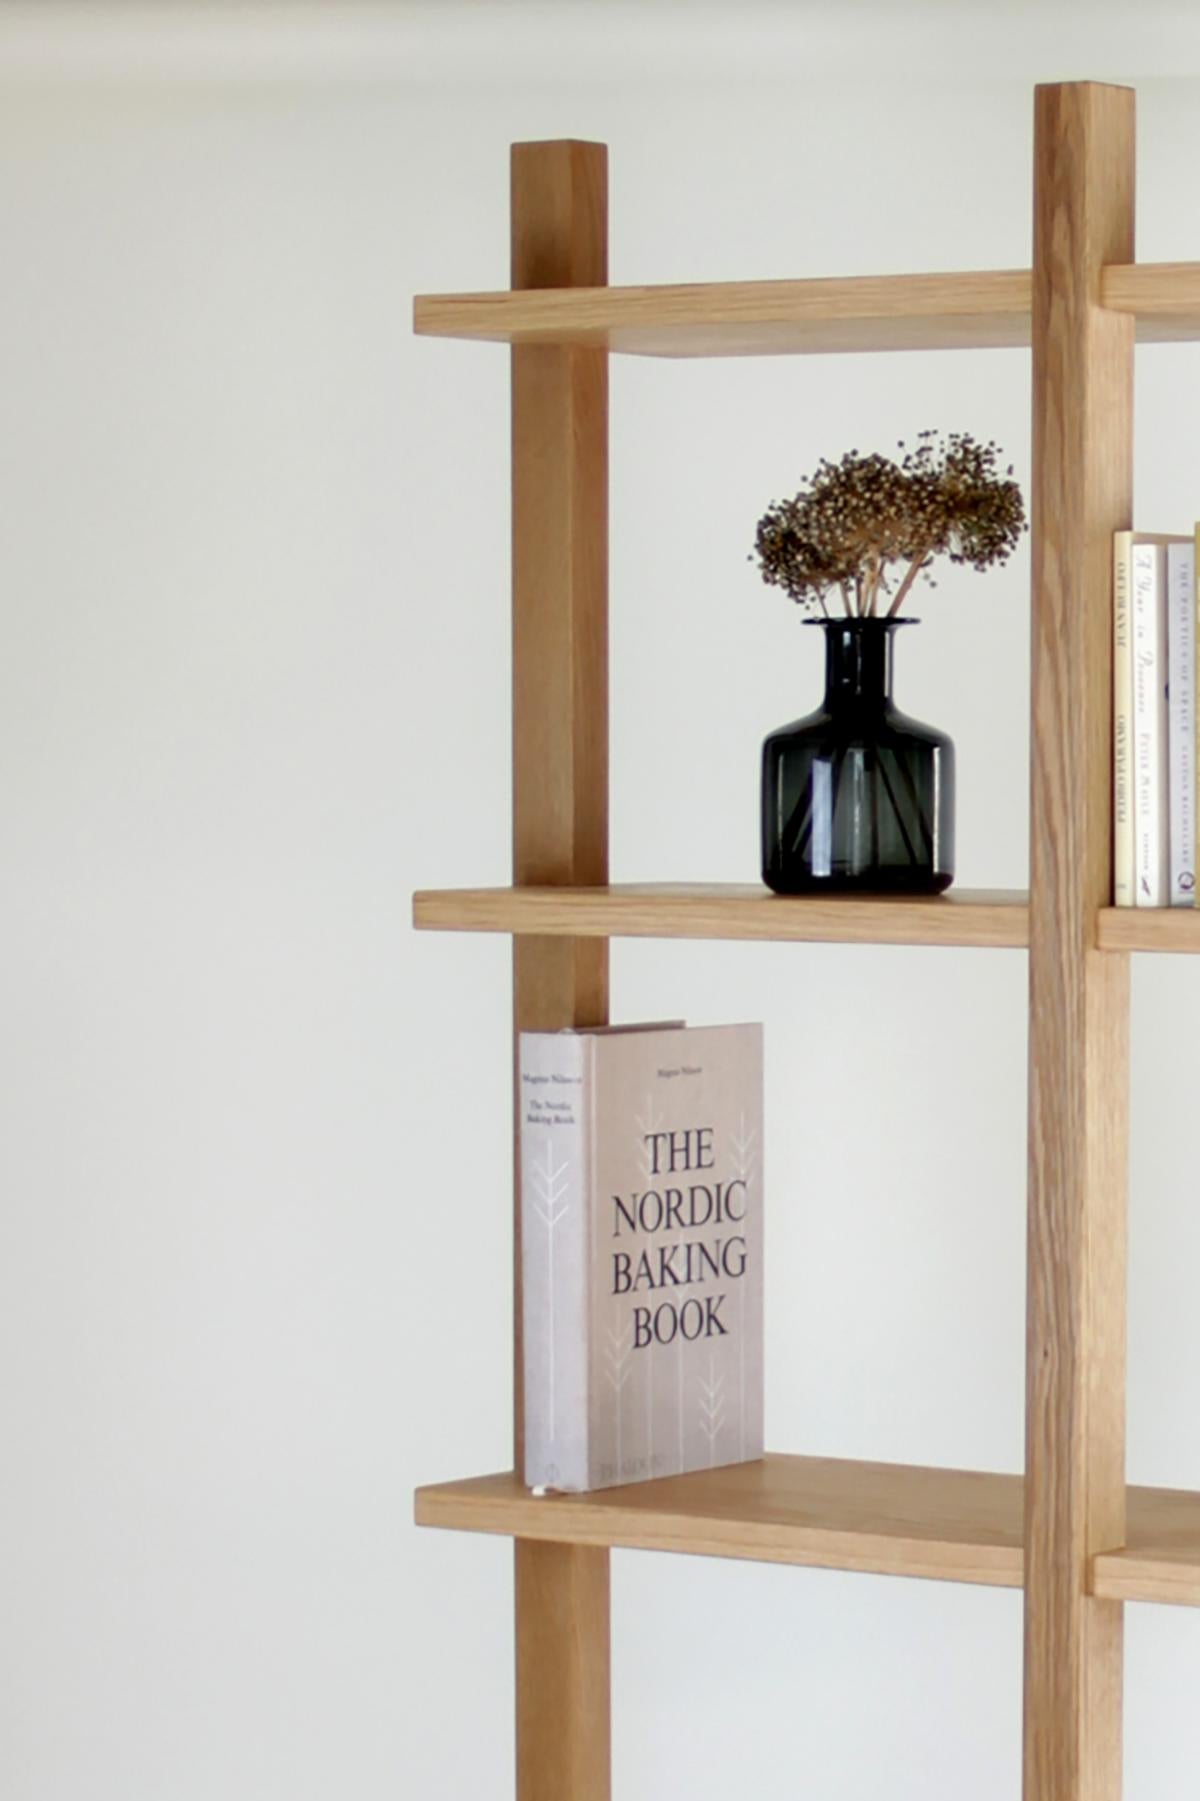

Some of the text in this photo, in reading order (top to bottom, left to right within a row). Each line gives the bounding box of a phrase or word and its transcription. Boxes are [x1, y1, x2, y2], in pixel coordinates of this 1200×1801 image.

[644, 1127, 715, 1175] THE
[612, 1179, 747, 1237] NORDIC
[611, 1236, 748, 1295] BAKING
[632, 1294, 729, 1349] BOOK
